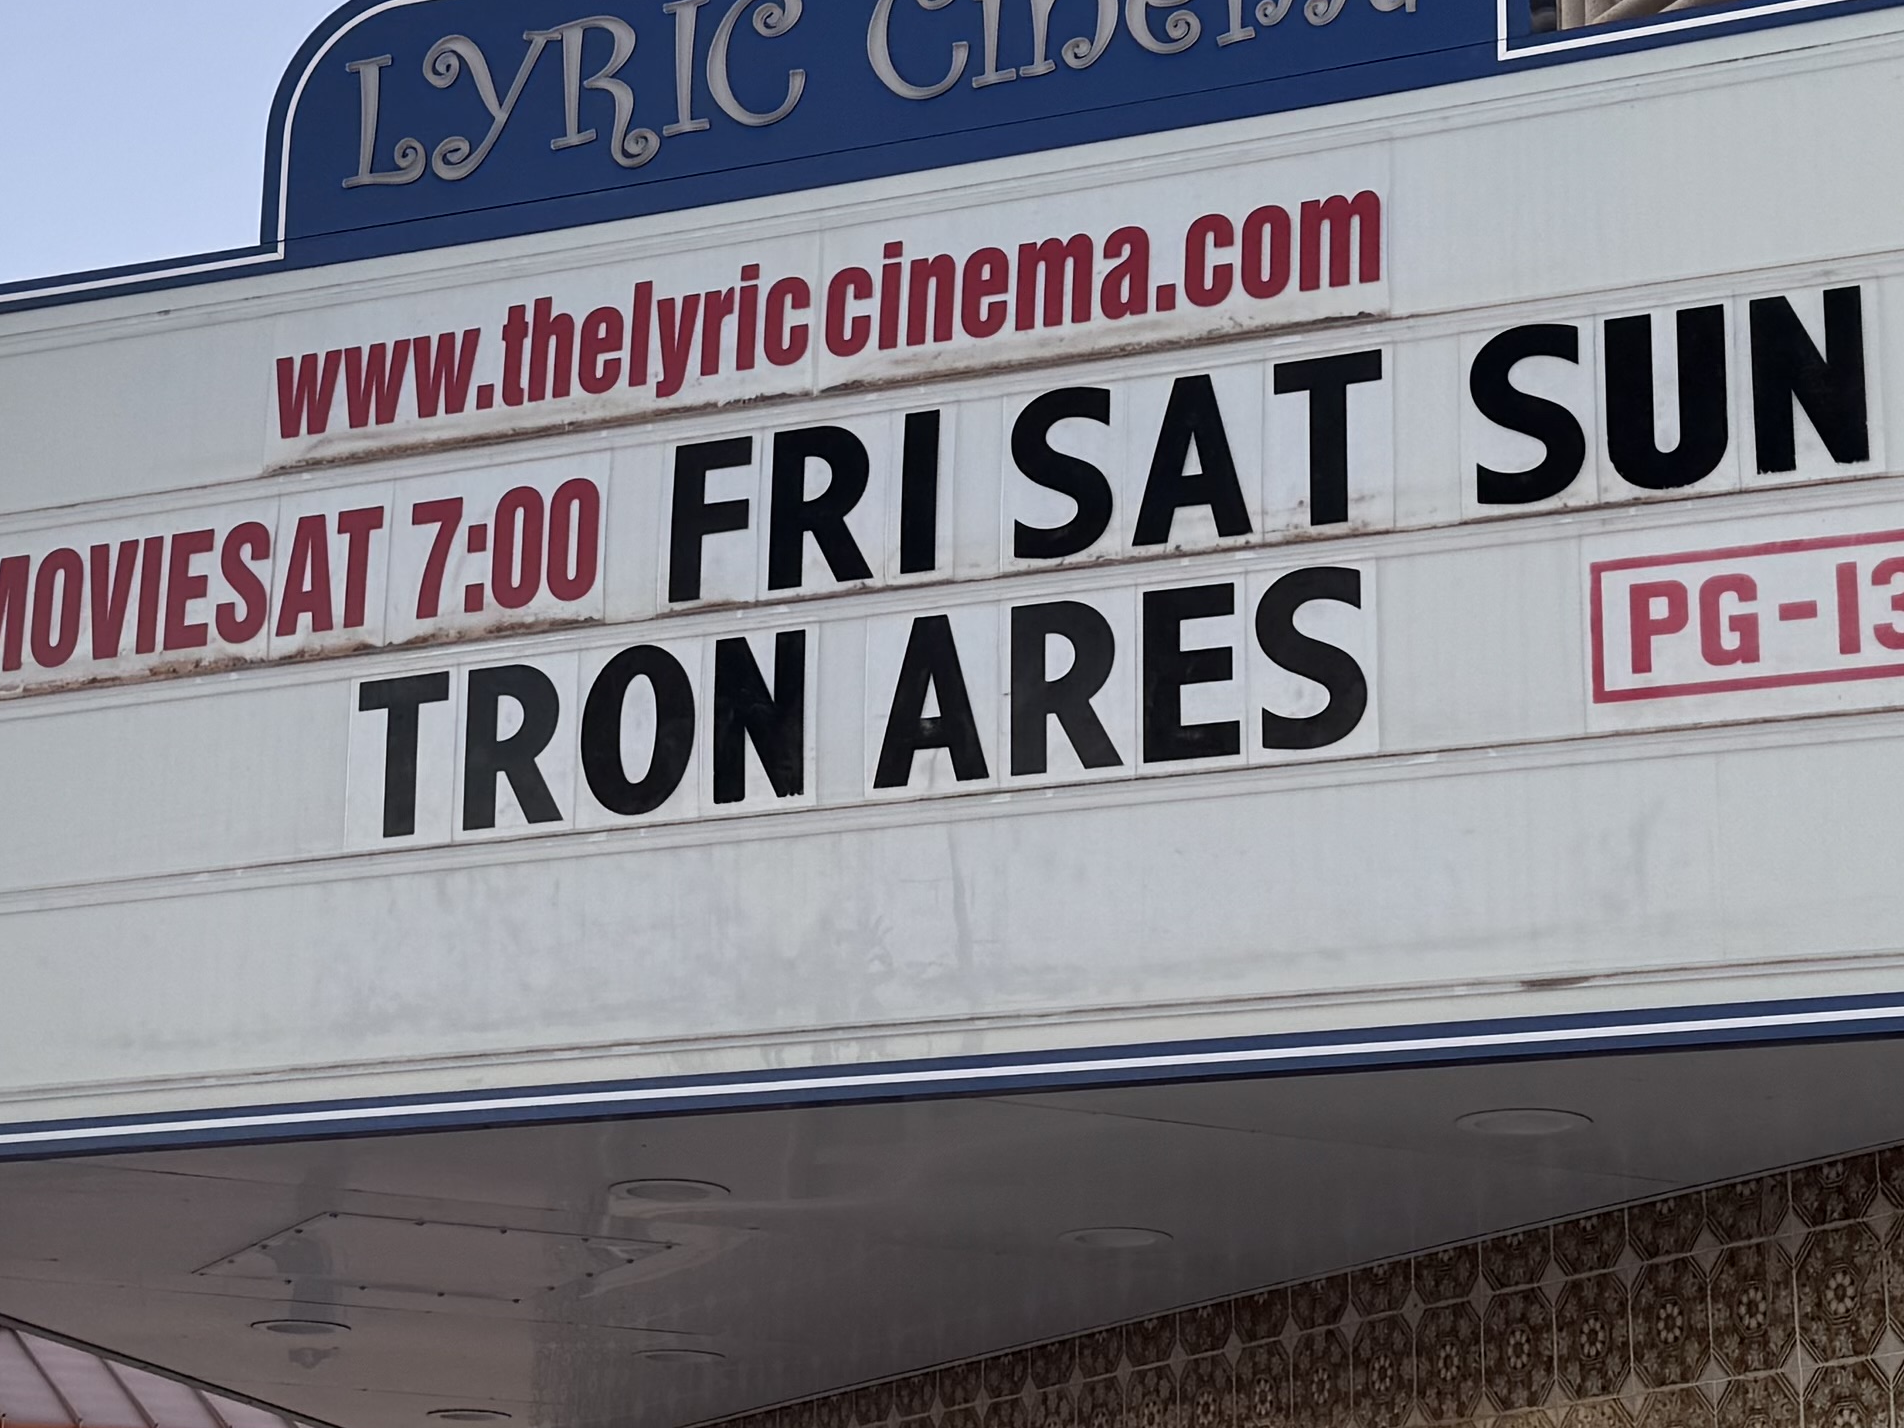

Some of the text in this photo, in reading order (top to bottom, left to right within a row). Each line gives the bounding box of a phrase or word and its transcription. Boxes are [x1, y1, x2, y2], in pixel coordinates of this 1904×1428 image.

[276, 190, 1382, 440] www.thelyriccinema.com
[411, 478, 600, 620] 7:00
[668, 410, 942, 605] FRI
[1010, 348, 1384, 561] SAT
[1469, 285, 1870, 506] SUN
[357, 566, 1369, 839] TRON ARES
